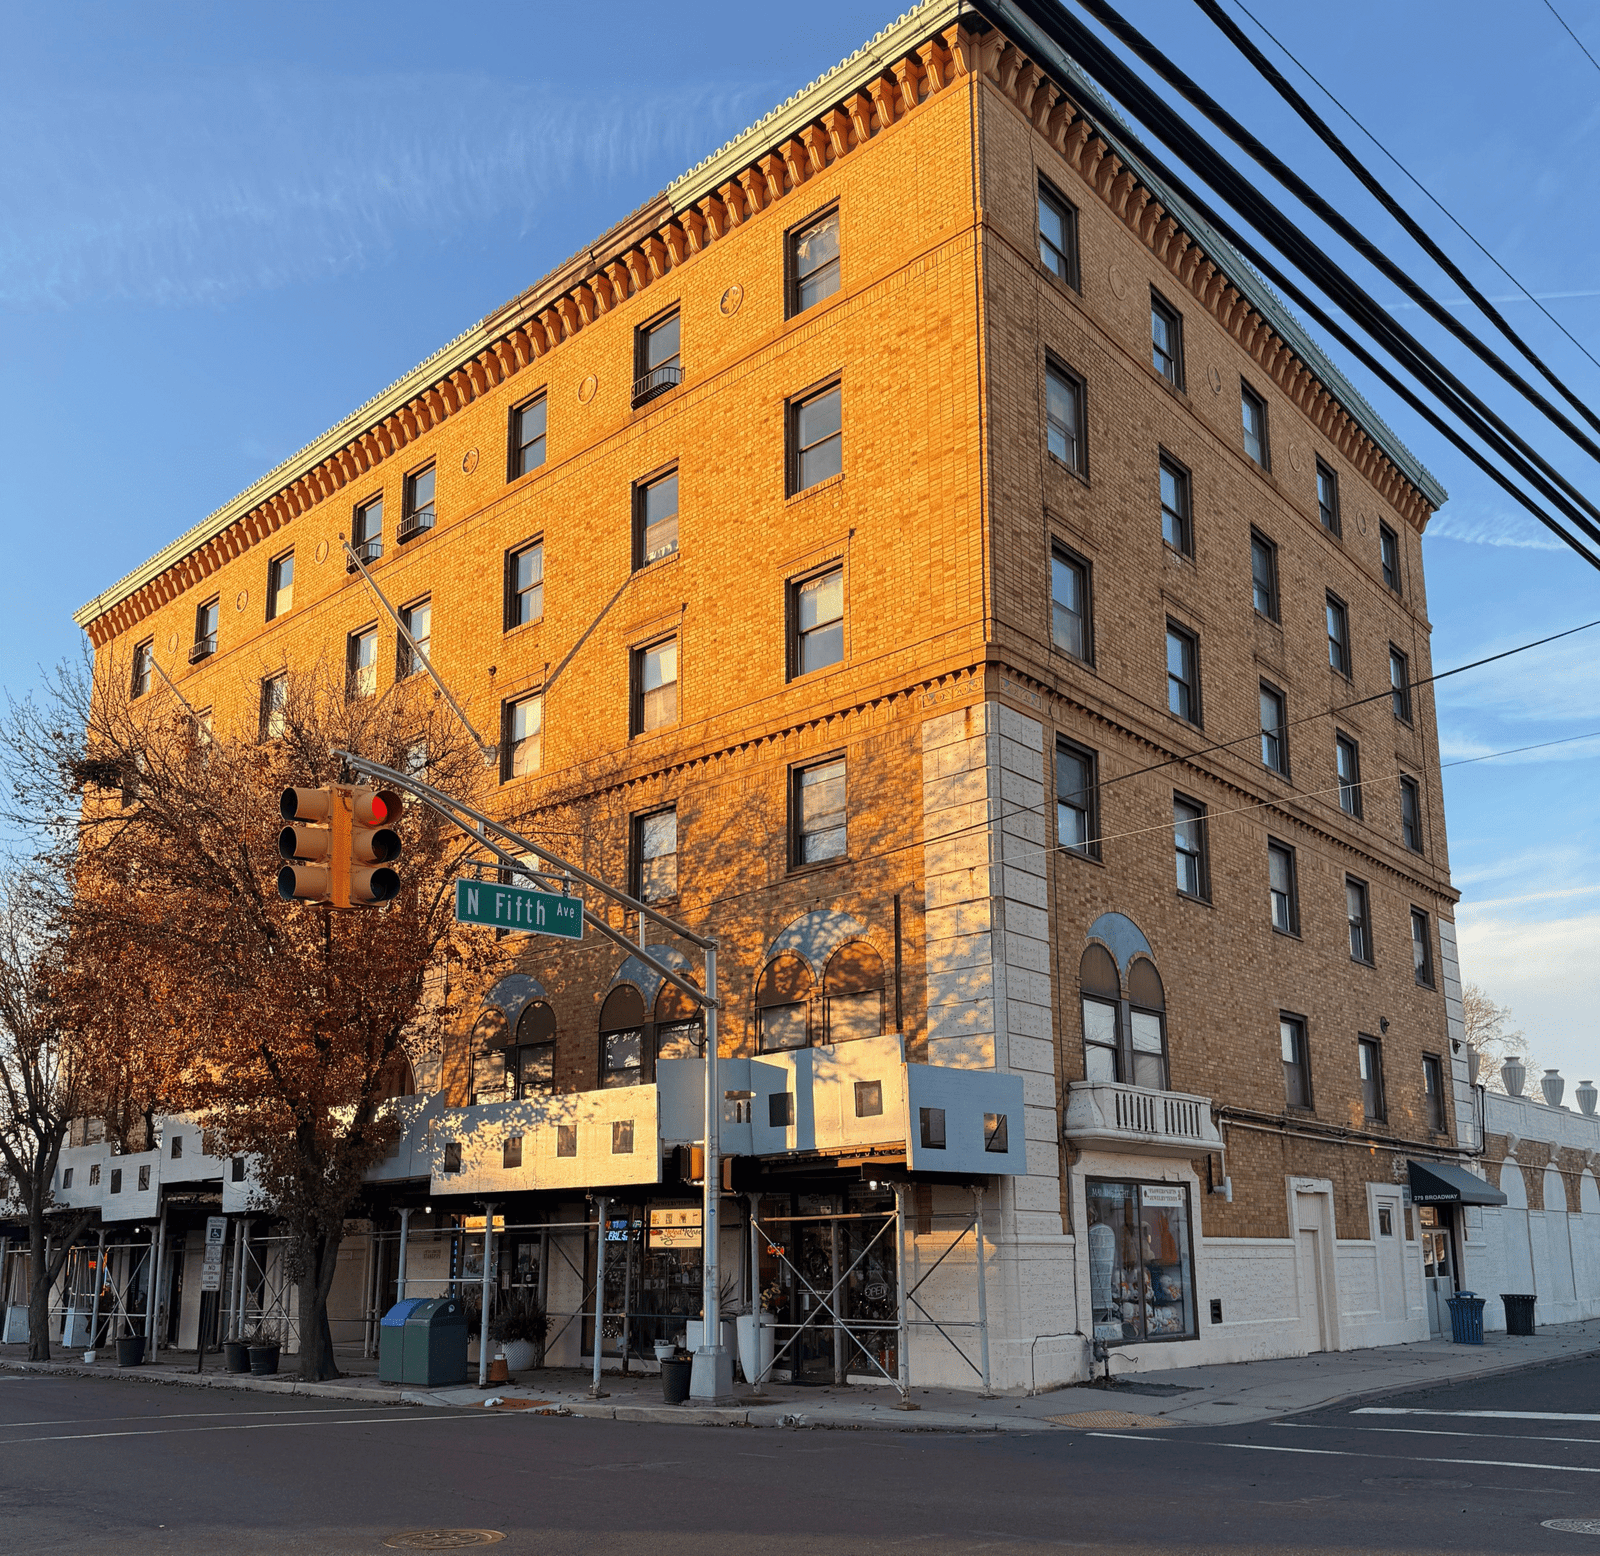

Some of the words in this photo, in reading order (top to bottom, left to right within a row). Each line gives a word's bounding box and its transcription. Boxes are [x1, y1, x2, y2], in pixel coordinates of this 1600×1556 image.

[467, 888, 479, 916] N
[495, 892, 546, 926] Fifth
[556, 902, 575, 919] Ave
[865, 1285, 887, 1298] OPEN
